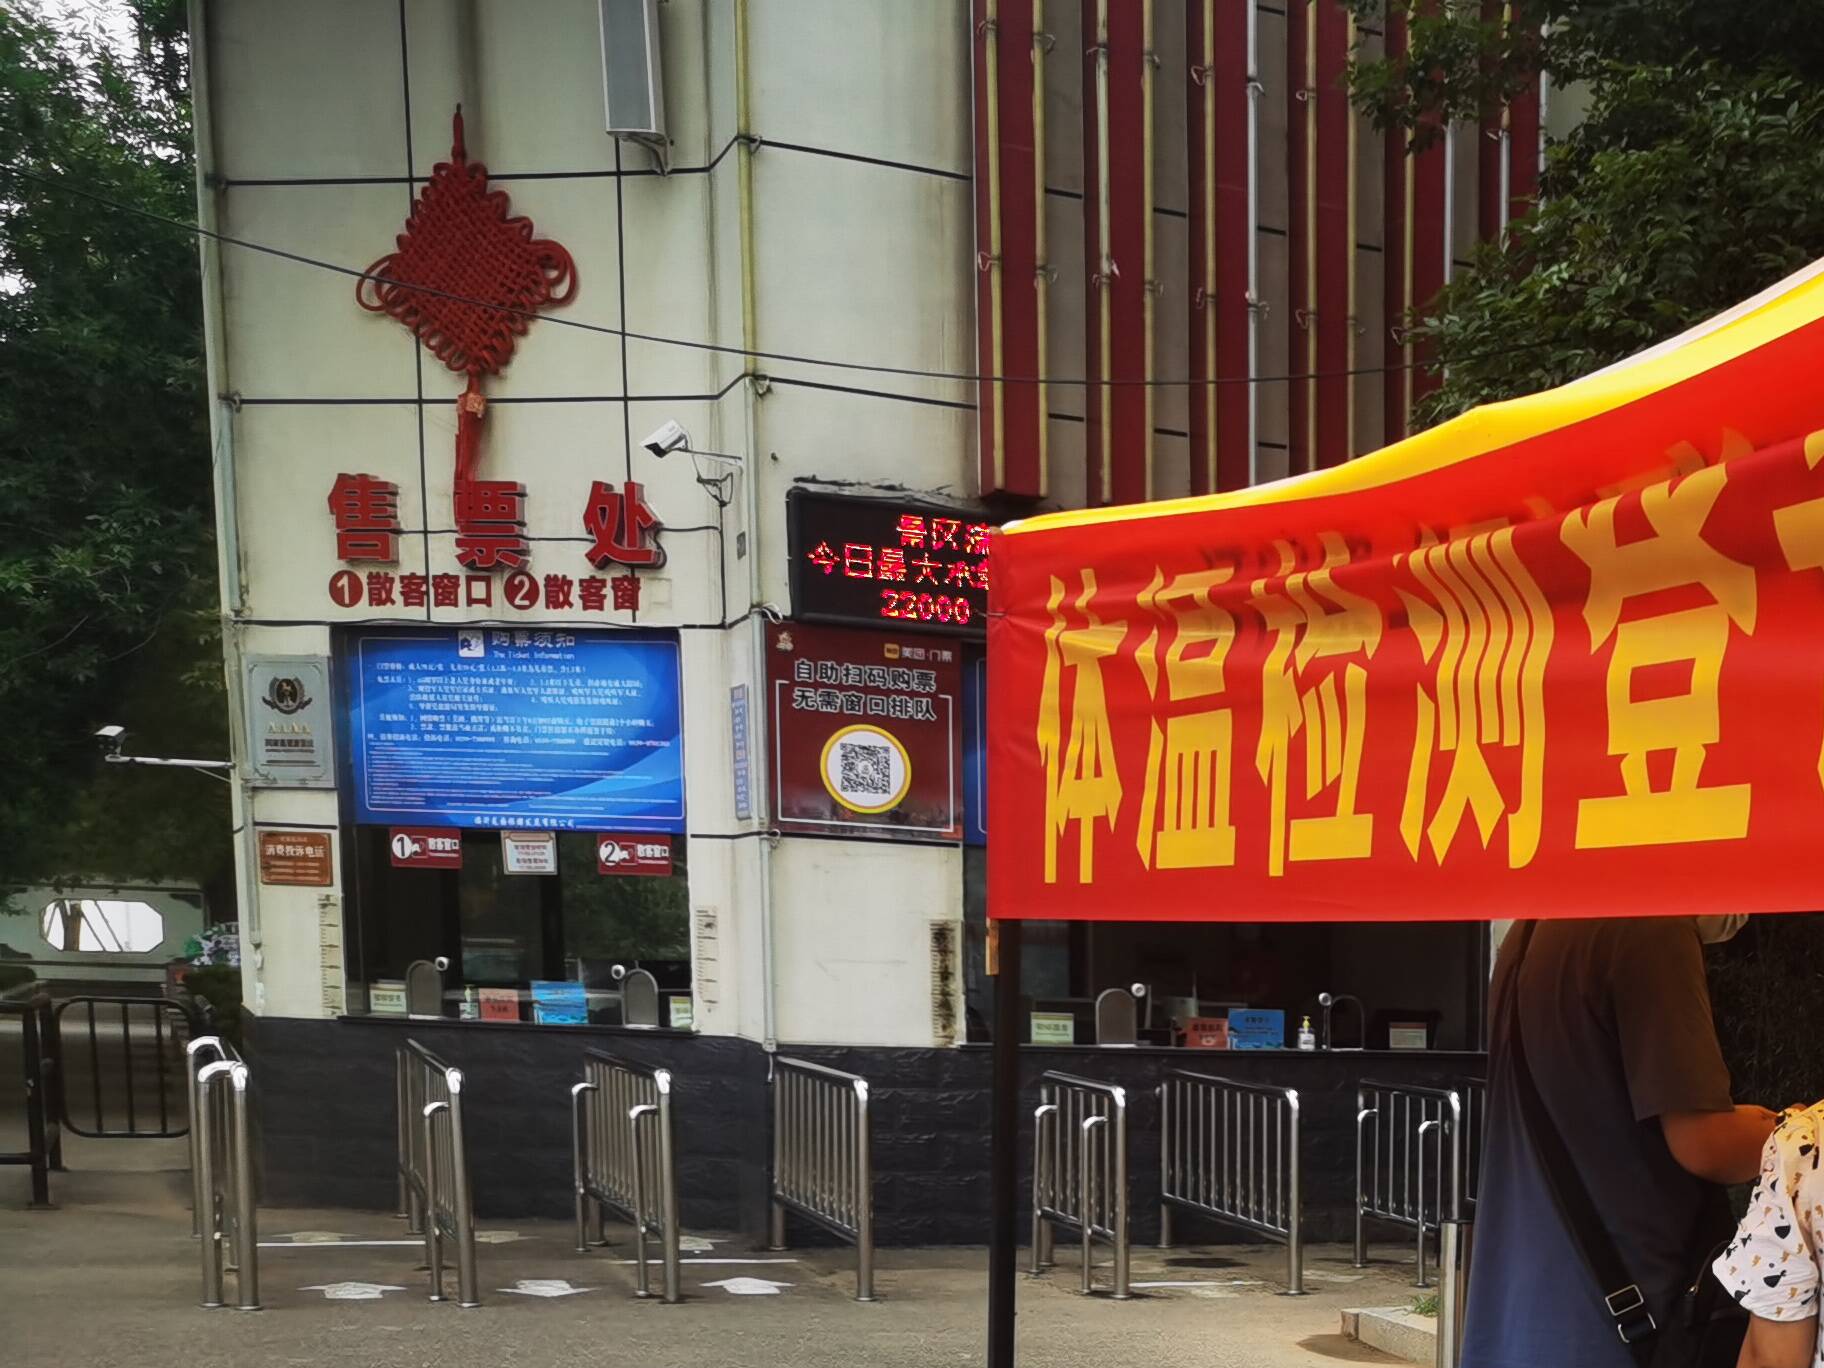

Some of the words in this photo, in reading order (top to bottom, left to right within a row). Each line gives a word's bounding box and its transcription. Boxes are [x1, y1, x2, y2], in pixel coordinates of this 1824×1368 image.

[327, 473, 667, 571] 售票处
[366, 572, 493, 608] 散客窗口
[544, 574, 641, 611] 散客窗
[880, 589, 970, 624] 22000
[794, 659, 938, 692] 自助扫码购票
[793, 687, 938, 721] 无需窗口排队
